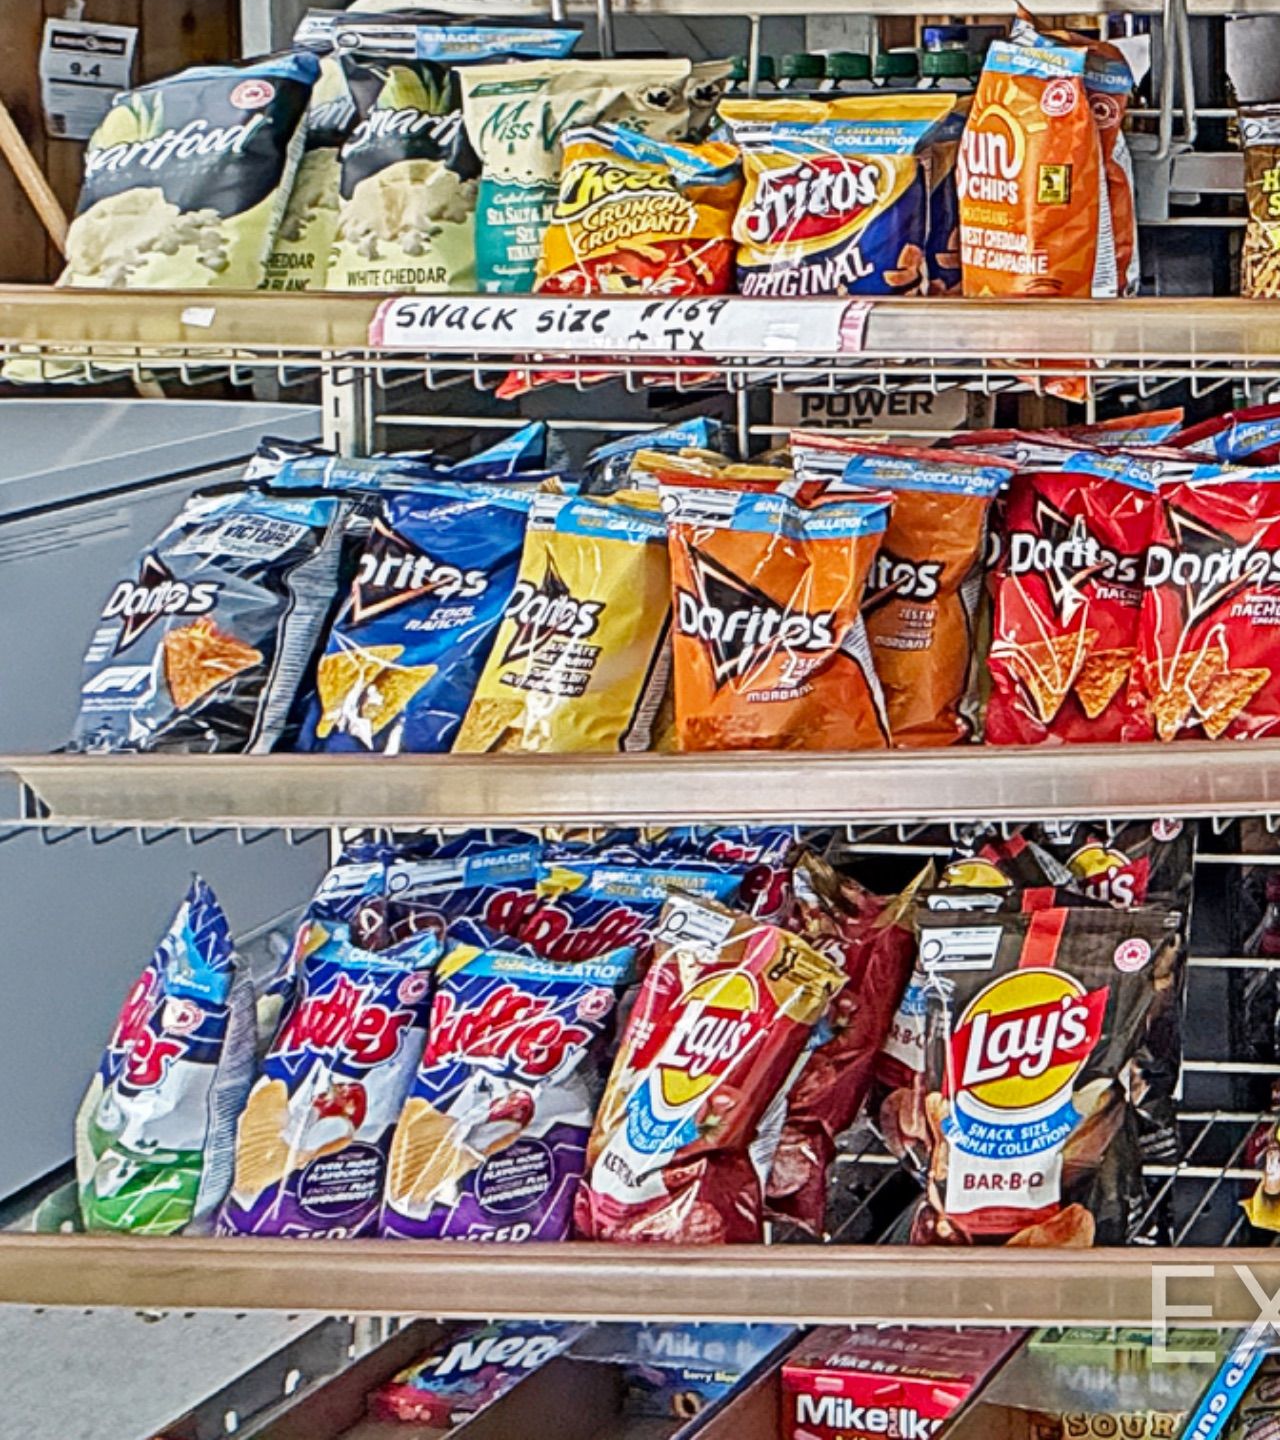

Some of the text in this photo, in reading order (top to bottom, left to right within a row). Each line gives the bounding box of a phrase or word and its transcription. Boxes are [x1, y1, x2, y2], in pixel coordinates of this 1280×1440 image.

[69, 61, 101, 78] 9.4
[479, 100, 535, 152] Miss
[740, 160, 884, 242] Fritos
[967, 181, 1018, 206] CHIPS
[582, 195, 692, 232] CRUNCHY
[575, 212, 693, 254] CROQUANT
[346, 266, 447, 286] WHITE CHEDDAR
[740, 248, 875, 298] ORIGINAL
[800, 389, 934, 418] POWER
[911, 470, 998, 490] COLLATION
[1009, 532, 1139, 583] Doritos
[101, 580, 222, 619] Doritos
[503, 582, 606, 639] Doritos
[677, 589, 838, 650] Doritos
[657, 998, 758, 1080] Lay's
[963, 997, 1090, 1087] Lay's
[968, 1122, 1049, 1141] SNACK SIZE
[997, 1125, 1071, 1157] COLLATION
[796, 1394, 891, 1431] Mike
[1066, 1412, 1177, 1440] SOUR
